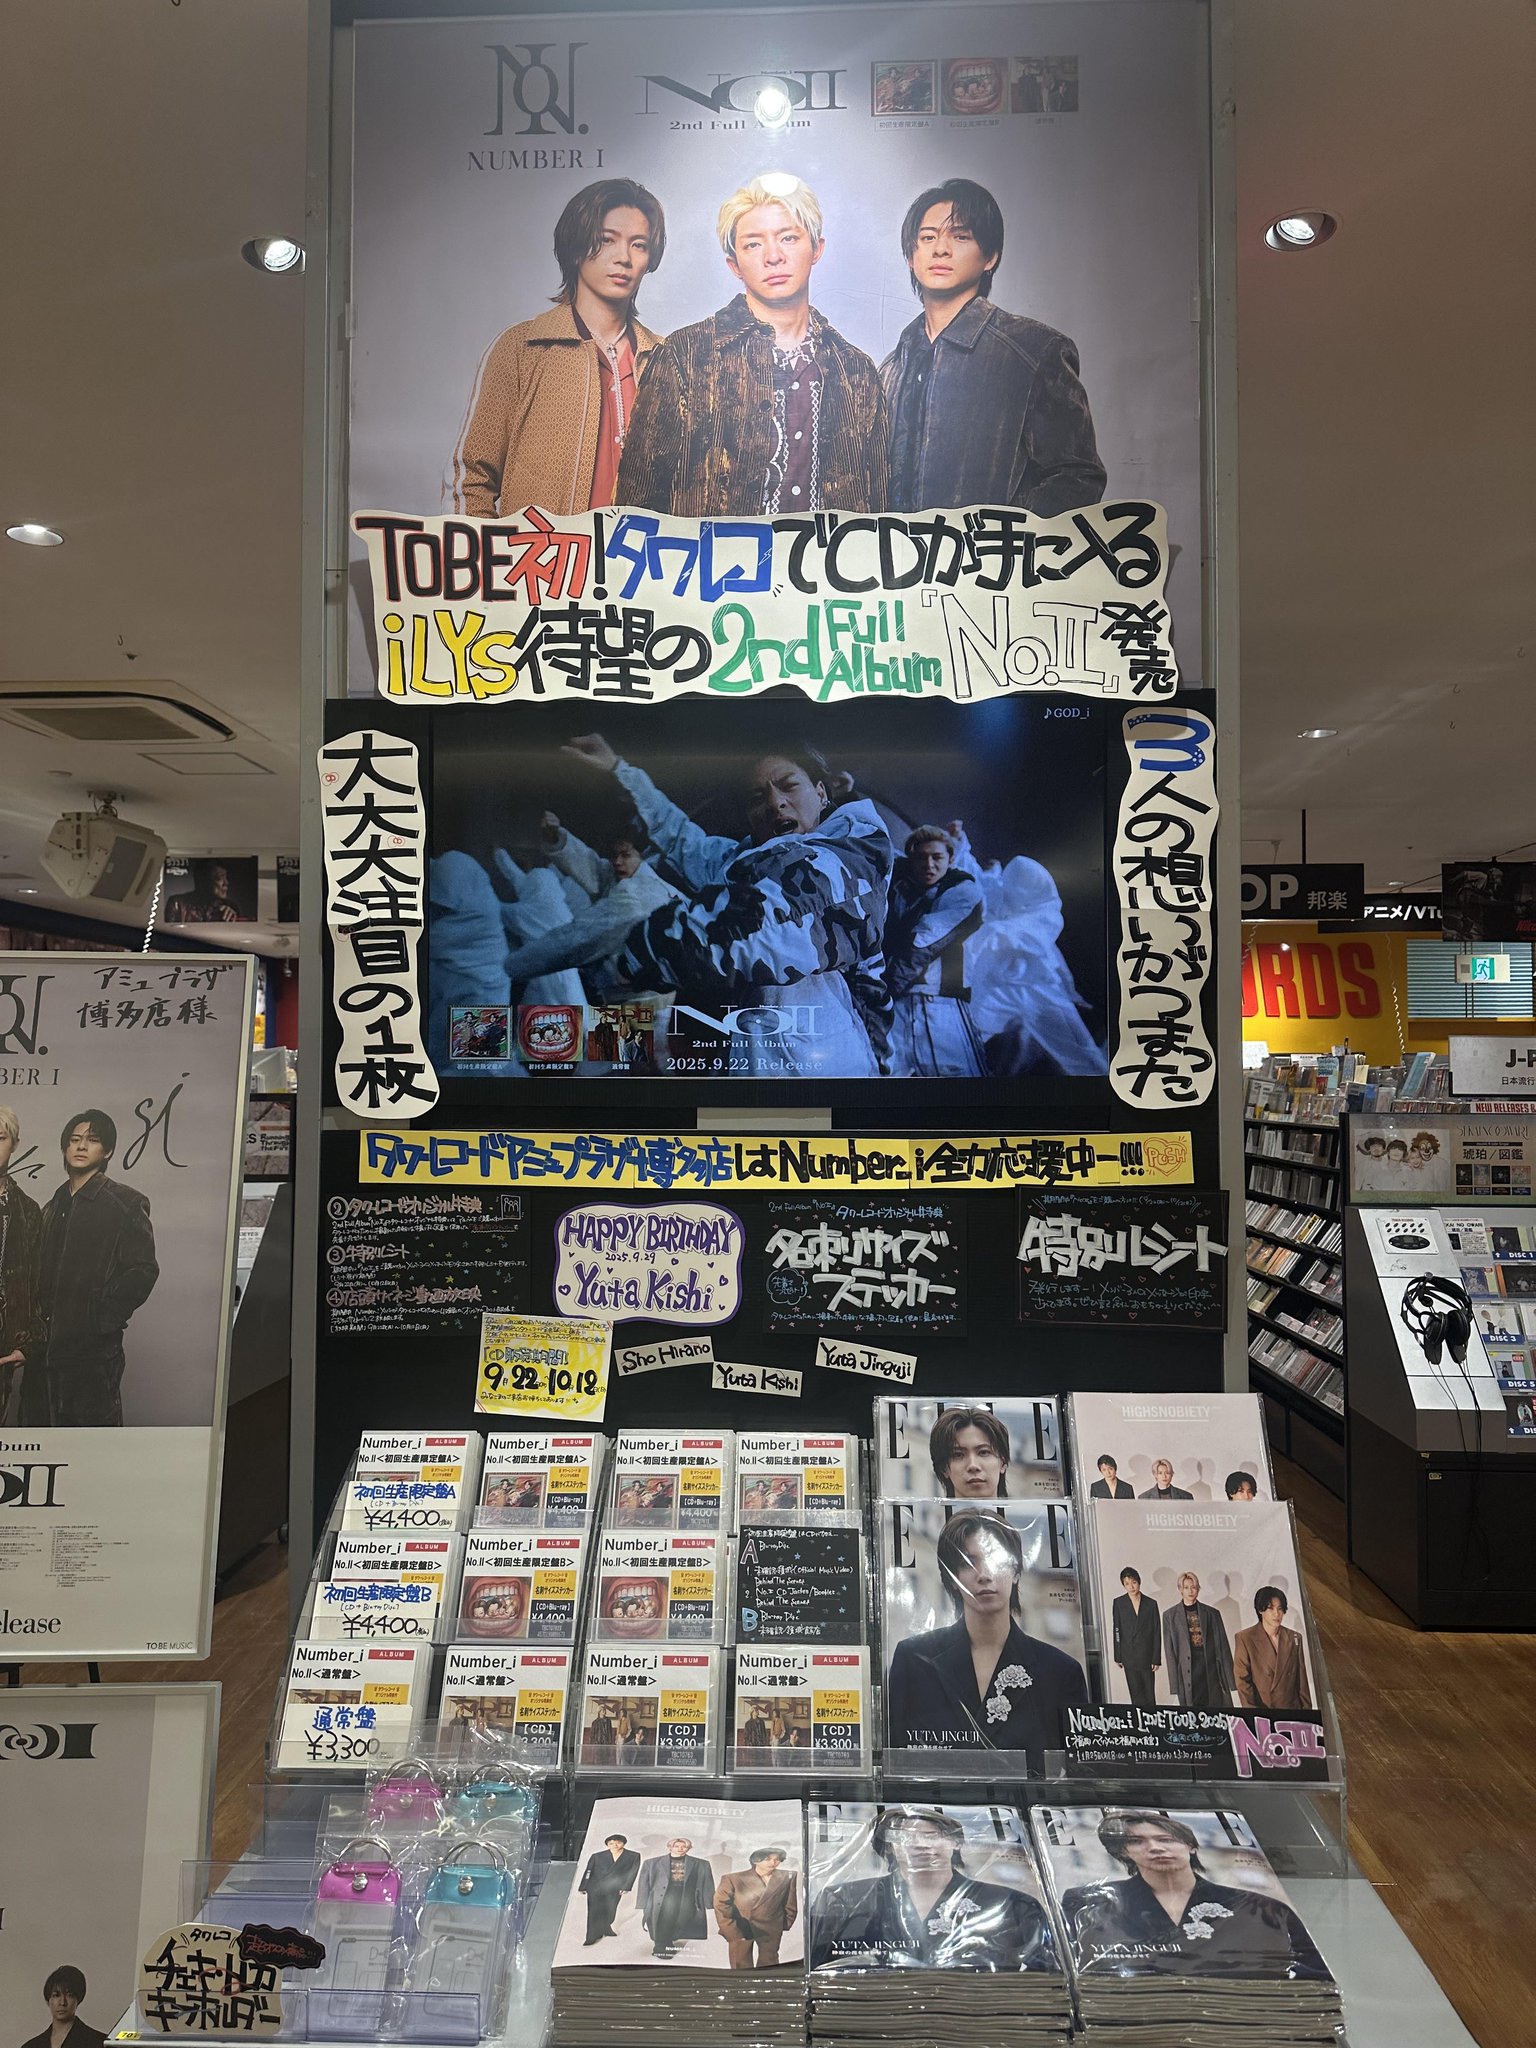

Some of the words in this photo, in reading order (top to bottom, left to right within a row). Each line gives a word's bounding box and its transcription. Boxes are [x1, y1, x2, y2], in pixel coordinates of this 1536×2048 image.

[669, 121, 703, 131] 2nd
[711, 120, 746, 130] Full
[824, 600, 905, 651] Full
[816, 643, 943, 701] Album
[1307, 890, 1348, 911] 邦楽
[322, 732, 438, 1108] 大大大注目の1枚
[76, 994, 218, 1029] 博多店様
[692, 1040, 718, 1049] 2nd
[720, 1039, 750, 1049] Full
[753, 1039, 797, 1049] Album
[666, 1056, 751, 1073] 2025.9.22
[755, 1056, 824, 1073] Release
[1475, 1103, 1494, 1113] NEW
[1494, 1102, 1529, 1113] RELEASES
[562, 1213, 645, 1252] HAPPY
[644, 1213, 738, 1255] BIRTHDAY
[765, 1221, 950, 1273] 名刺サイズ
[1016, 1212, 1229, 1278] 特別レシート
[574, 1262, 641, 1309] Yuta
[645, 1268, 713, 1313] Kishi
[812, 1267, 957, 1312] ステッカー
[622, 1350, 657, 1374] Sho
[819, 1341, 857, 1369] Yuta
[859, 1349, 912, 1381] Jinguji
[716, 1364, 757, 1389] Yuta
[1507, 1380, 1527, 1388] DISC
[1121, 1405, 1211, 1418] HIGHSNOBIETY
[887, 1402, 1058, 1461] EE
[362, 1437, 422, 1449] Number_i
[489, 1438, 549, 1450] Number_i
[619, 1439, 679, 1452] Number_i
[741, 1439, 800, 1451] Number_i
[354, 1482, 457, 1501] 初回生産限定盤A
[364, 1506, 440, 1531] ¥4,400
[1145, 1513, 1238, 1527] HIGHSNOBIETY
[888, 1503, 1075, 1569] EE
[338, 1541, 401, 1555] Number_i
[469, 1538, 532, 1552] Number_i
[604, 1538, 668, 1553] Number_i
[740, 1538, 759, 1565] A
[323, 1583, 432, 1603] 初回生産限定盤B
[0, 1609, 61, 1635] lease
[342, 1613, 418, 1640] ¥4,400
[741, 1607, 759, 1632] B
[146, 1642, 168, 1650] TOBE
[169, 1641, 193, 1650] MUSIC
[296, 1647, 364, 1662] Number_i
[449, 1654, 517, 1669] Number_i
[589, 1654, 657, 1669] Number_i
[739, 1653, 808, 1669] Number_i
[312, 1705, 377, 1731] 通常盤
[665, 1724, 698, 1736] 【CD】
[818, 1724, 852, 1736] 【CD】
[906, 1730, 940, 1742] YUTA
[940, 1730, 981, 1744] JINGUJI
[304, 1730, 381, 1761] ¥3,300
[189, 1928, 231, 1942] タワレコ
[830, 1940, 869, 1949] YUTA
[870, 1940, 921, 1949] JINGUJI
[1089, 1943, 1128, 1952] YUTA
[1130, 1943, 1182, 1952] JINGUJI
